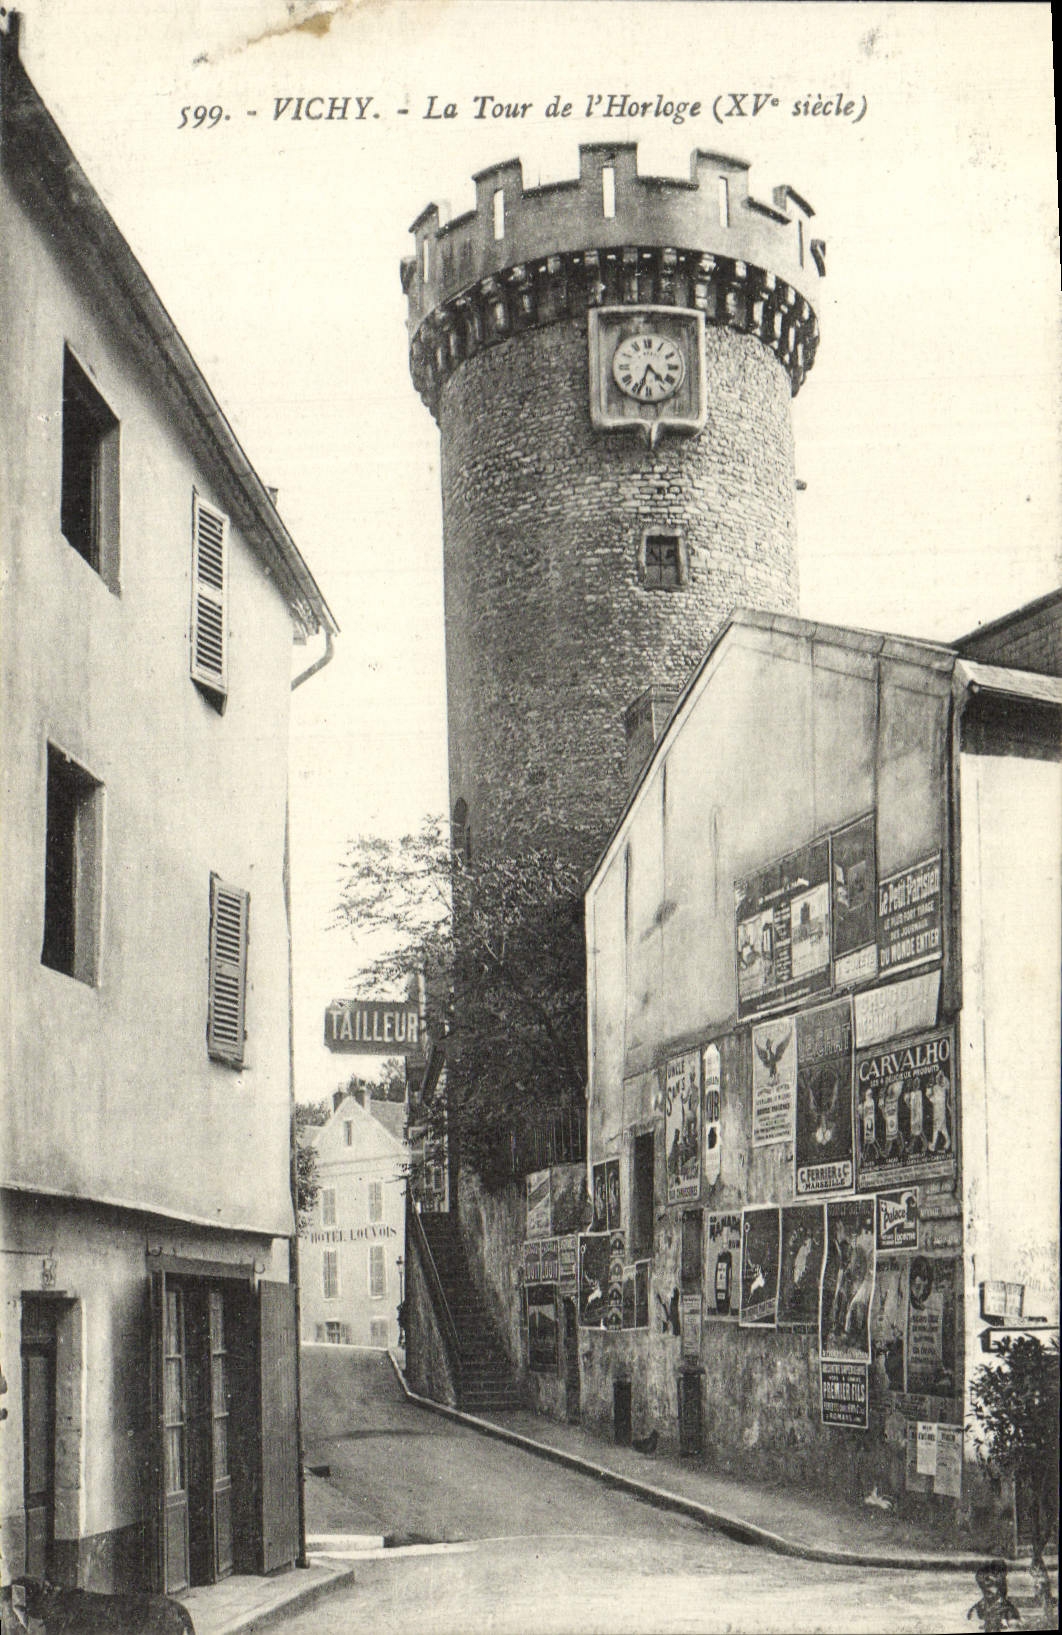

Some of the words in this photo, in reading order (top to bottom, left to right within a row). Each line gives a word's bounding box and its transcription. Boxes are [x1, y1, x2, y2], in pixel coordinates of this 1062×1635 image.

[891, 936, 915, 963] MONDE
[916, 926, 940, 956] ENTIER
[328, 1009, 419, 1043] TAILLEUR
[859, 1039, 950, 1081] CARVALHO
[805, 1177, 846, 1191] MARSEILLE
[310, 1229, 346, 1244] HOTEL
[823, 1381, 851, 1402] PREMIER
[851, 1383, 866, 1404] FILS
